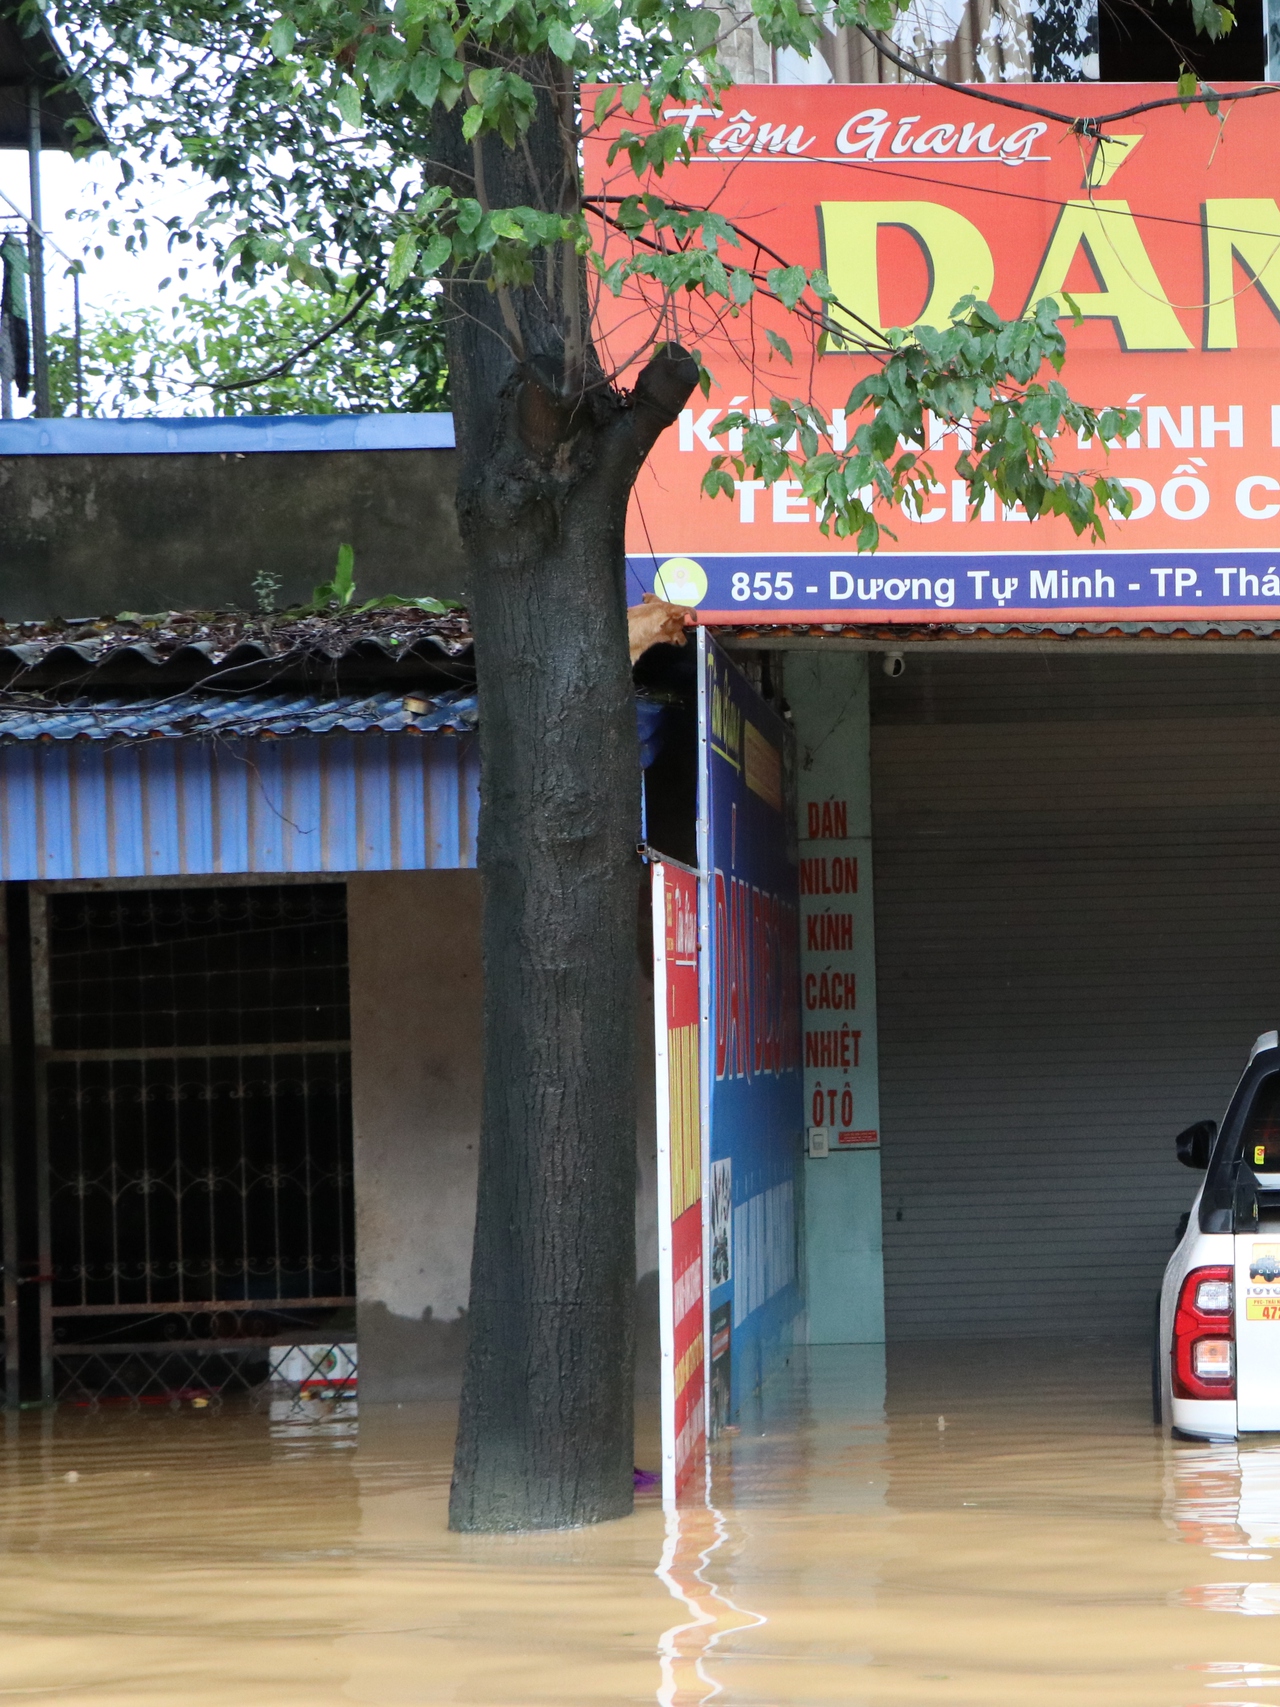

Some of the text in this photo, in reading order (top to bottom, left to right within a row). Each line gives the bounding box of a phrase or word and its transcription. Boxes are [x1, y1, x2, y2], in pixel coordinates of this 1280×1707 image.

[663, 104, 1048, 166] Tâm Giang
[1078, 393, 1244, 449] ÍNH
[734, 481, 873, 522] TE
[901, 459, 1043, 522] CH
[731, 572, 793, 601] 855
[829, 570, 955, 607] Dương
[967, 570, 1018, 606] Tự
[1030, 569, 1114, 598] Minh
[1151, 568, 1202, 597] TP.
[808, 794, 847, 838] DÁN
[800, 857, 858, 895] NILON
[807, 907, 853, 951] KÍNH
[805, 965, 856, 1010] CÁCH
[805, 1022, 862, 1074] NHIỆT
